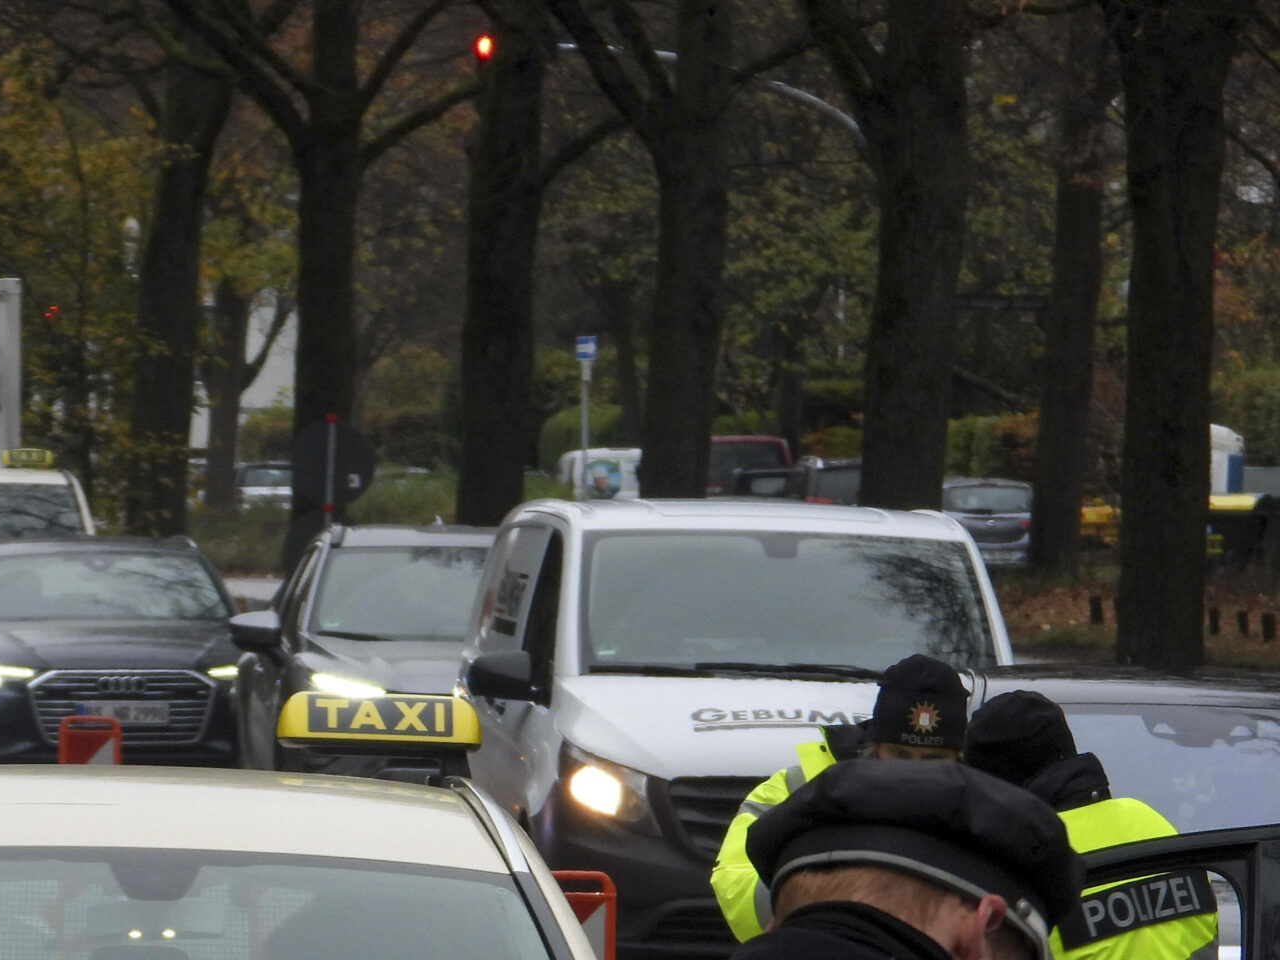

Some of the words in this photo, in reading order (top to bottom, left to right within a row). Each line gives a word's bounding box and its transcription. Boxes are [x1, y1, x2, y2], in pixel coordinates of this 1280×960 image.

[315, 698, 446, 732] TAXI
[901, 733, 944, 745] POLIZEI
[1081, 875, 1201, 937] POLIZEI
